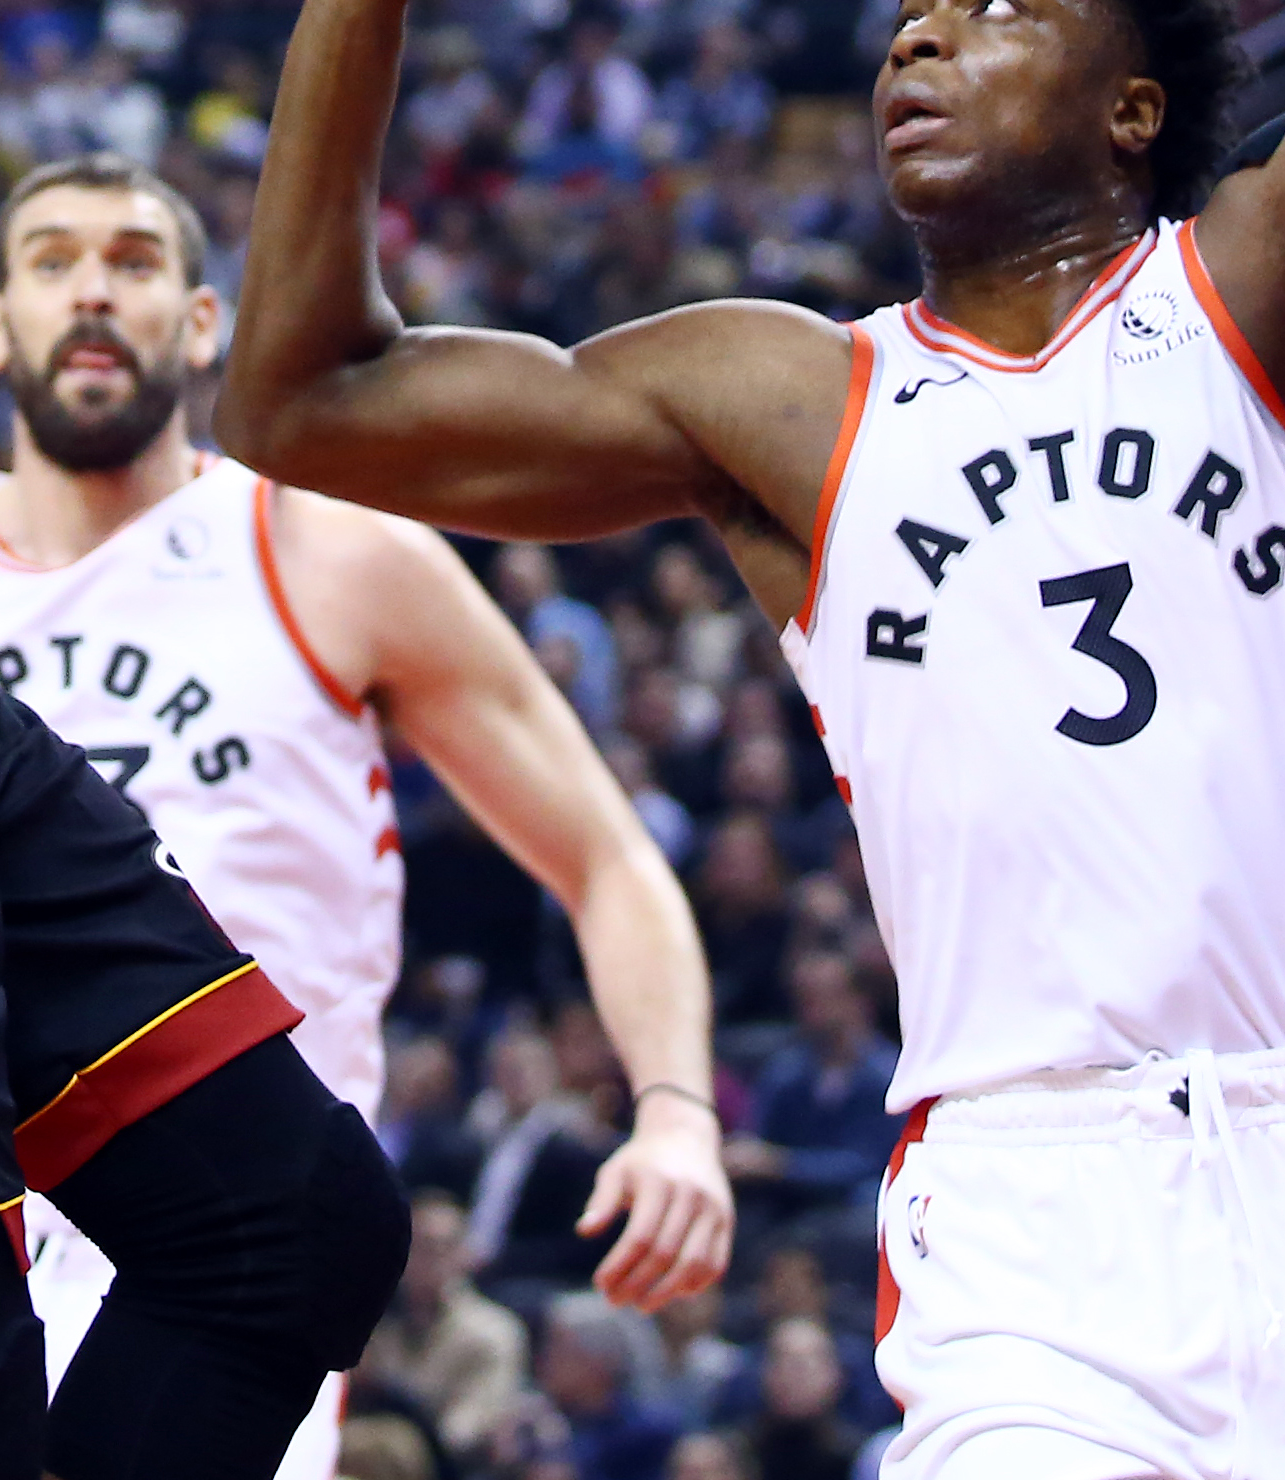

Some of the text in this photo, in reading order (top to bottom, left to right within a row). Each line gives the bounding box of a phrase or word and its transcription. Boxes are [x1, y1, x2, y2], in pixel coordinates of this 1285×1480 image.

[1113, 321, 1206, 366] Sun Life
[1038, 561, 1157, 746] 3
